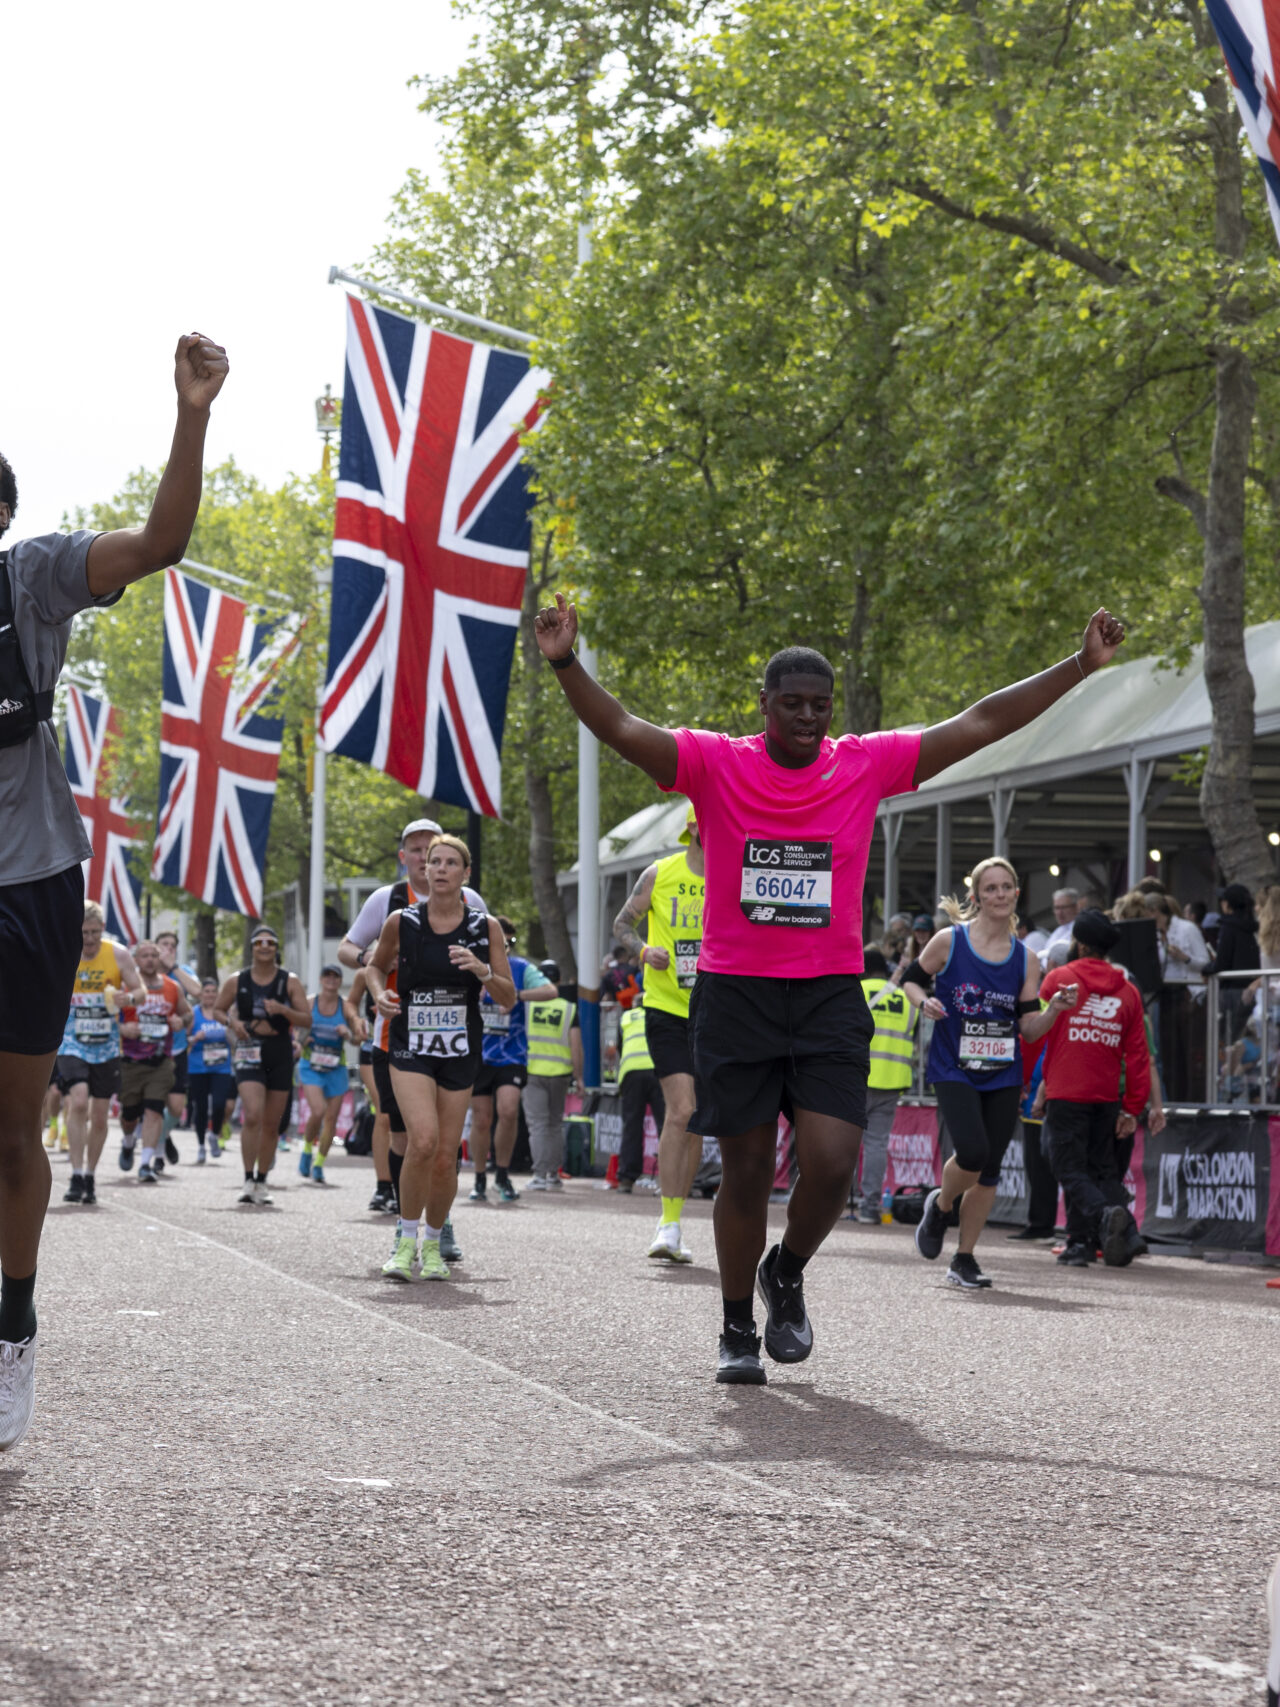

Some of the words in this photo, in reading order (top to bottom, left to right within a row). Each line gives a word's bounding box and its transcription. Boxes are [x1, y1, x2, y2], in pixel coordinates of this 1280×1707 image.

[749, 843, 781, 865] tcs
[783, 852, 827, 860] CONSULTANCY
[755, 876, 817, 900] 66047
[775, 915, 790, 923] new
[791, 915, 823, 924] balance
[682, 960, 696, 973] 32
[412, 990, 433, 1004] tcs
[417, 1011, 458, 1026] 61145
[965, 1021, 985, 1035] tcs
[1069, 1028, 1121, 1048] DOCOR
[969, 1040, 1007, 1056] 32106
[1205, 1151, 1256, 1186] LONDON
[1186, 1186, 1257, 1223] MARATHON
